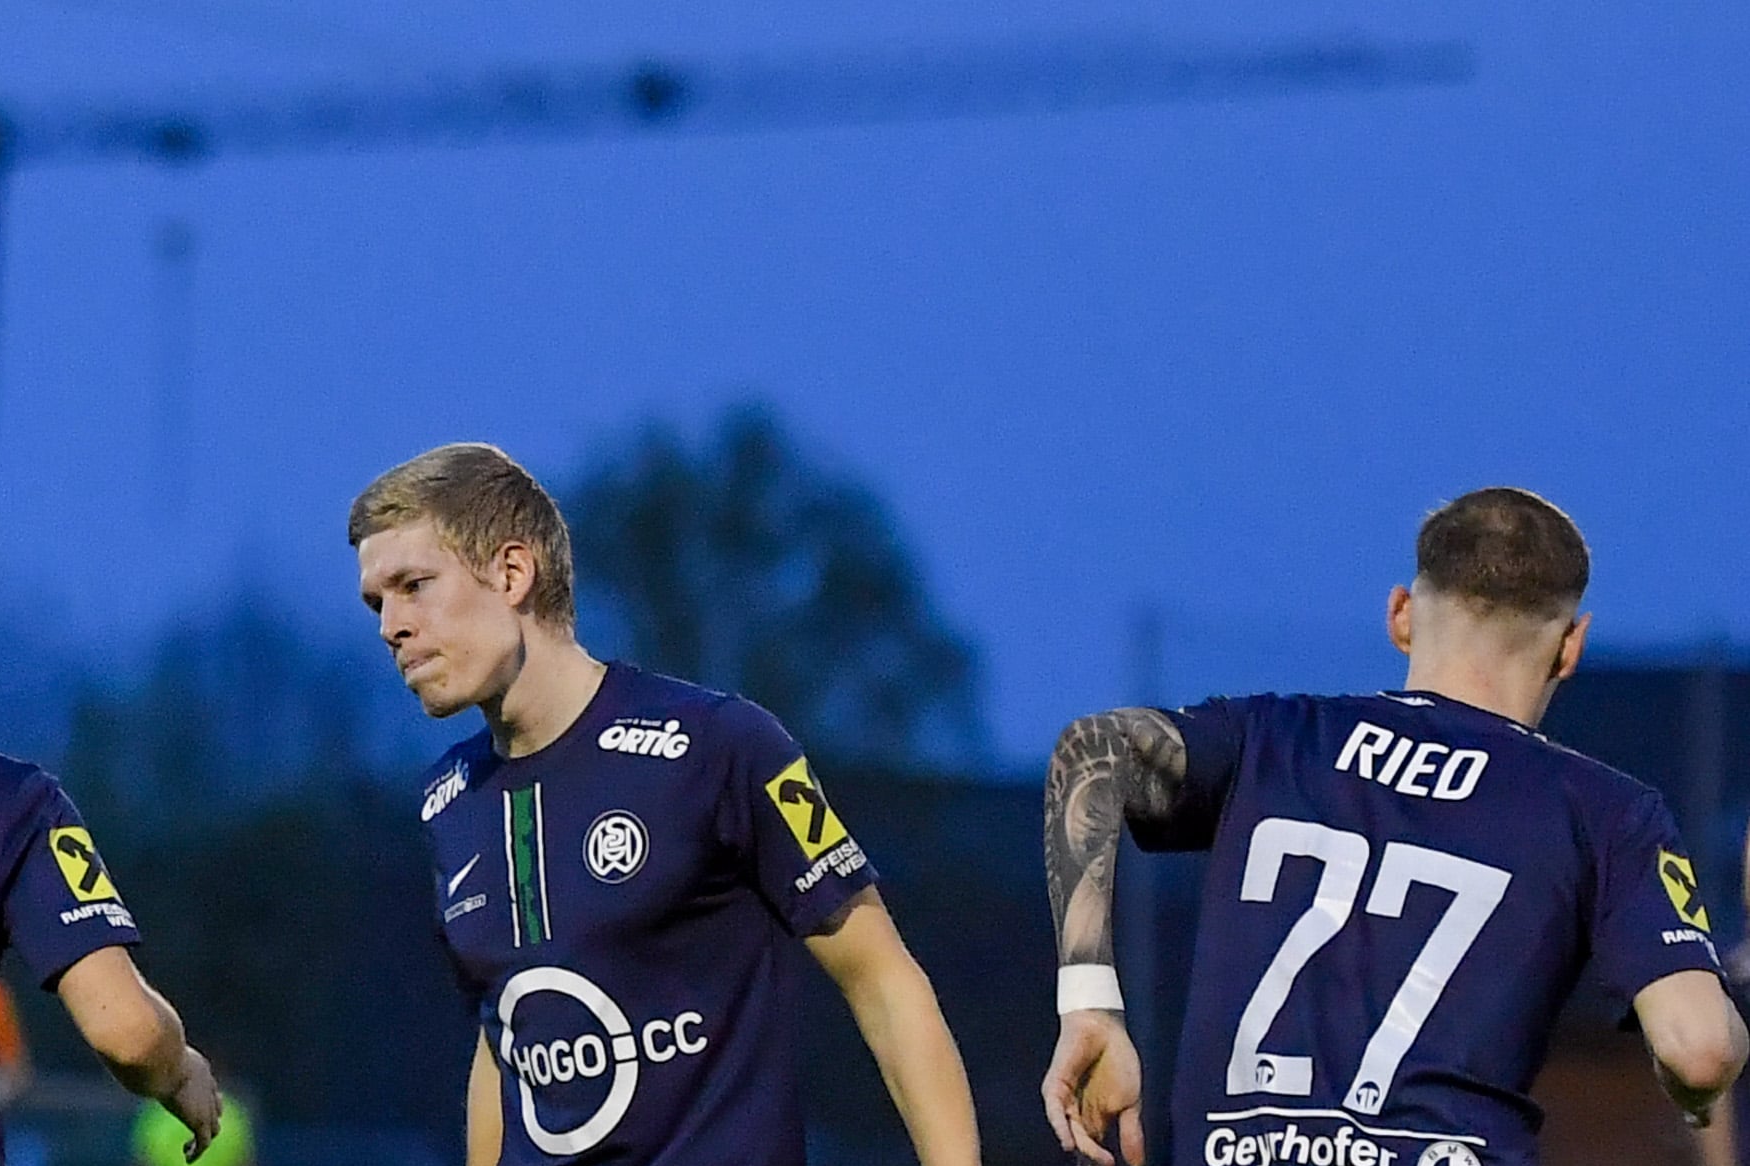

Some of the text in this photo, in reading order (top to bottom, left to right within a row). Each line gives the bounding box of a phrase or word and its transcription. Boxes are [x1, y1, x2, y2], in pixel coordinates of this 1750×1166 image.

[1335, 721, 1489, 801] RIED
[1226, 817, 1513, 1116] 27
[513, 1011, 709, 1087] HOGO CC
